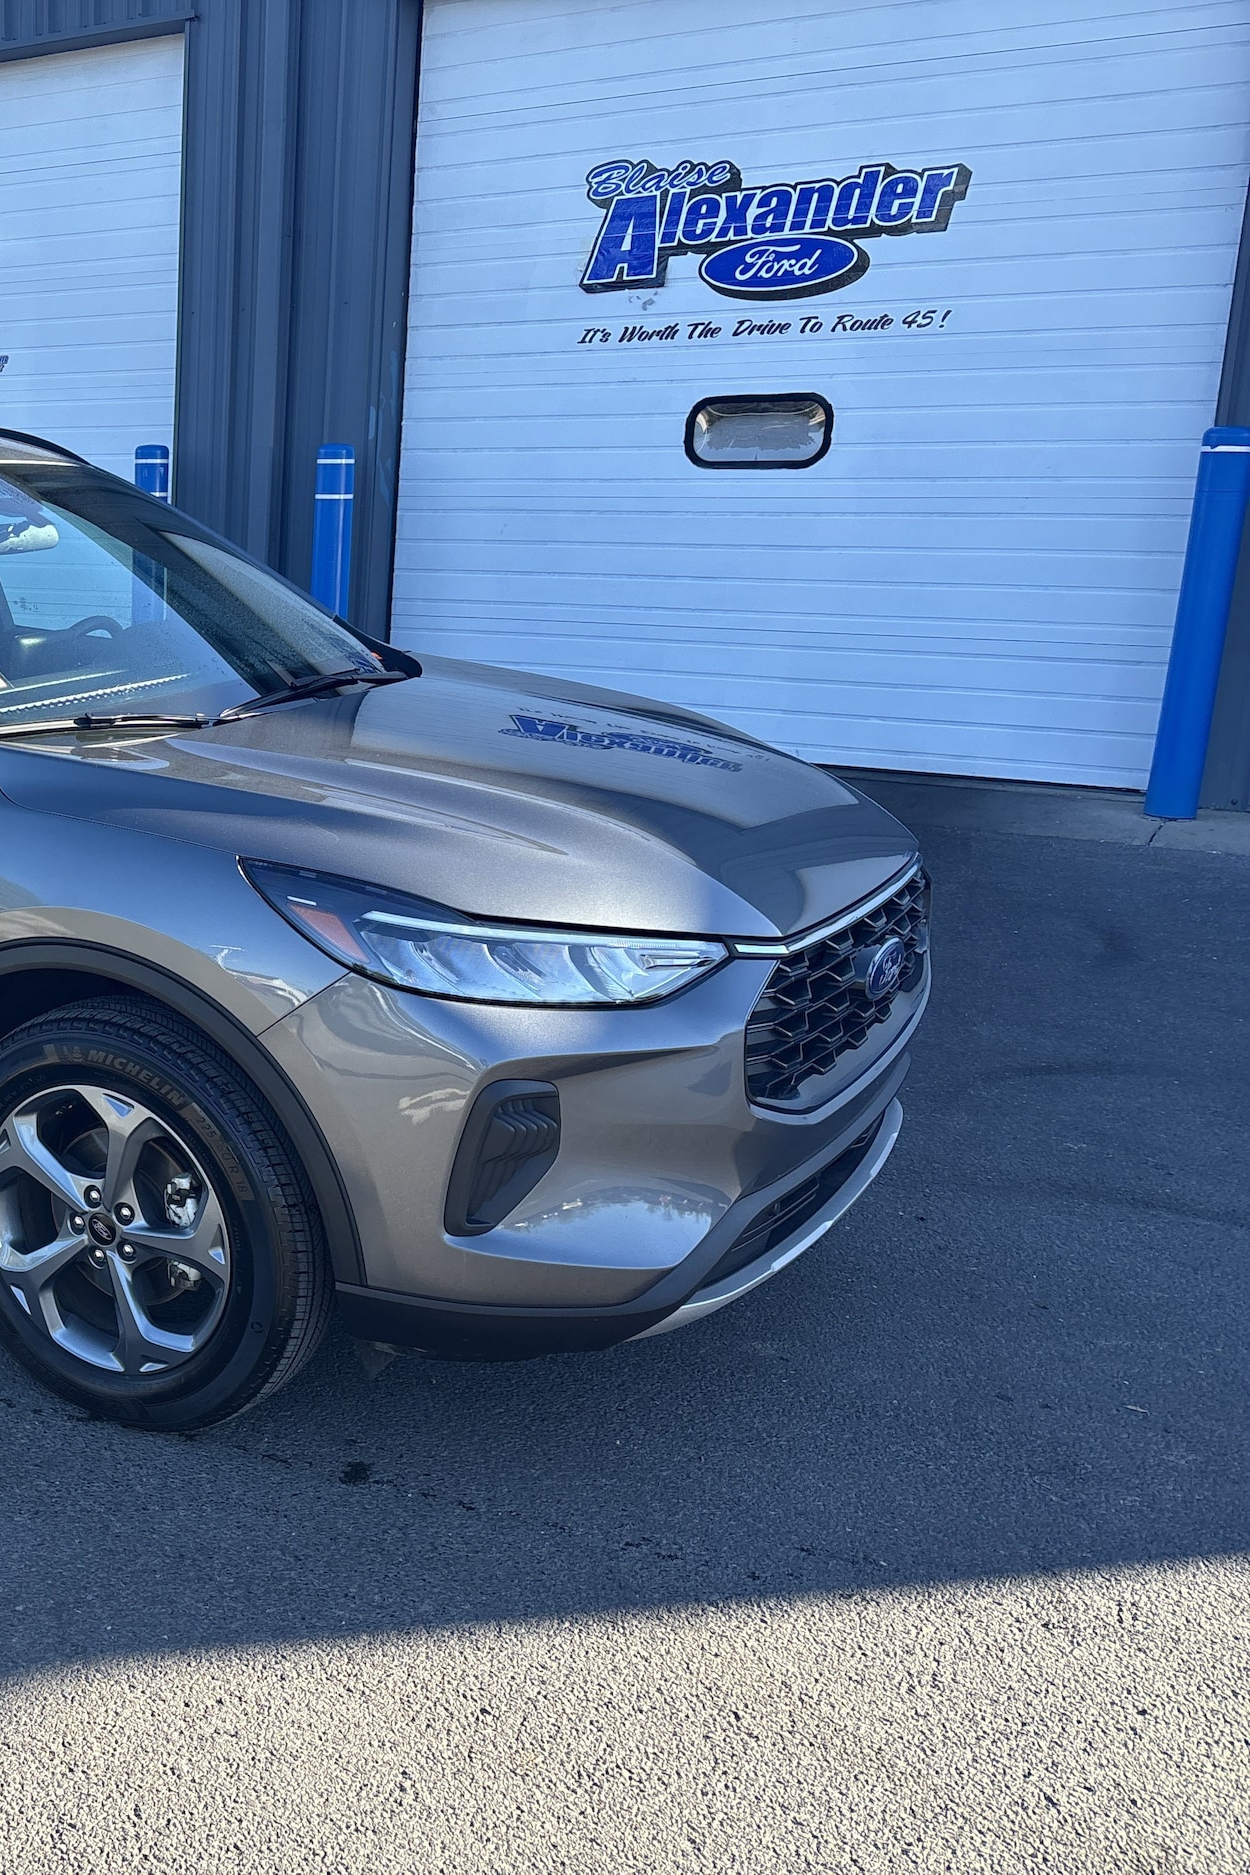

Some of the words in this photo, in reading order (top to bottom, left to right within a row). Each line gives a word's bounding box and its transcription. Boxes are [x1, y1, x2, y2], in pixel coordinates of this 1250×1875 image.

[588, 159, 731, 198] Blaise
[583, 164, 956, 284] Alexander
[734, 243, 820, 281] Ford
[577, 327, 611, 344] It's
[618, 322, 680, 343] Worth
[687, 320, 723, 340] The
[732, 319, 792, 337] Drive
[799, 315, 823, 334] To
[830, 313, 895, 333] Route
[87, 1049, 187, 1107] MICHELIN
